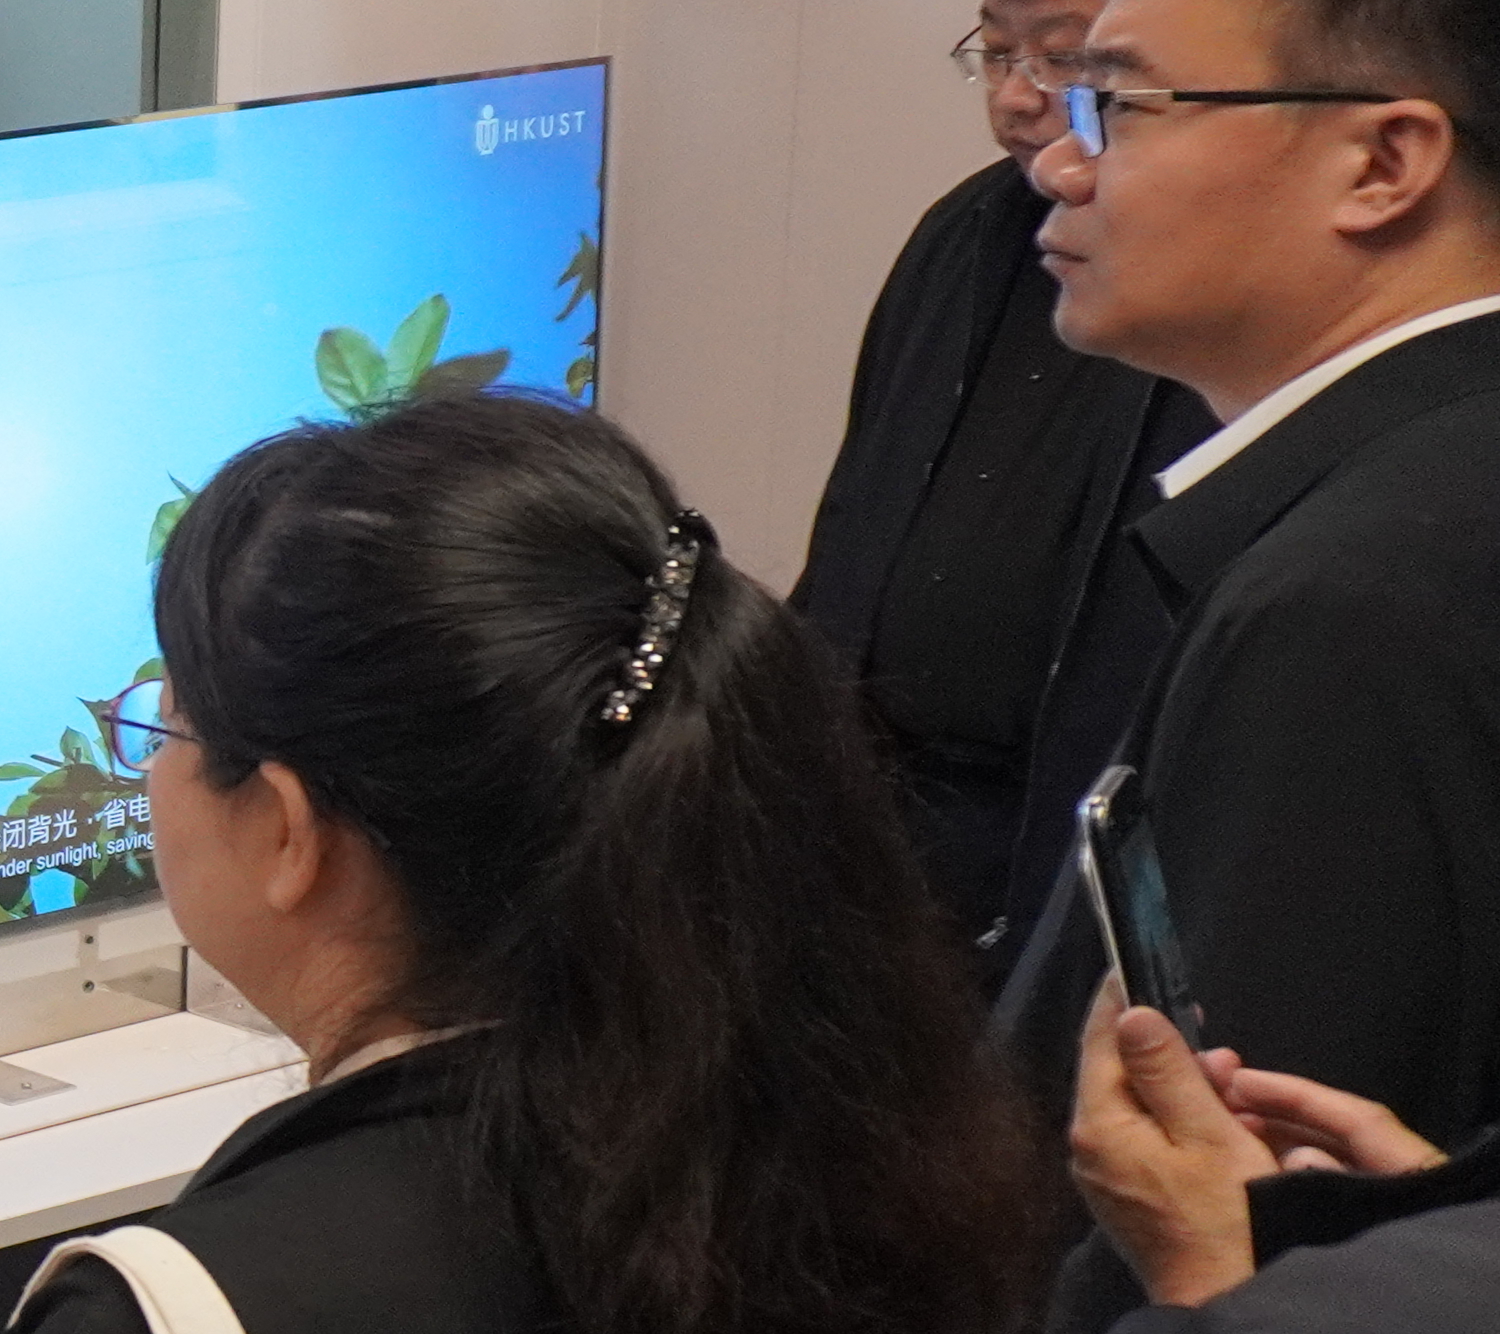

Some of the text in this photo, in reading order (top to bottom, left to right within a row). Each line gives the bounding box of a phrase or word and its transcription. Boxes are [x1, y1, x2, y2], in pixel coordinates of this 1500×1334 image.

[505, 111, 586, 142] HKUST
[36, 843, 102, 872] sunlight,
[106, 831, 156, 856] saving
